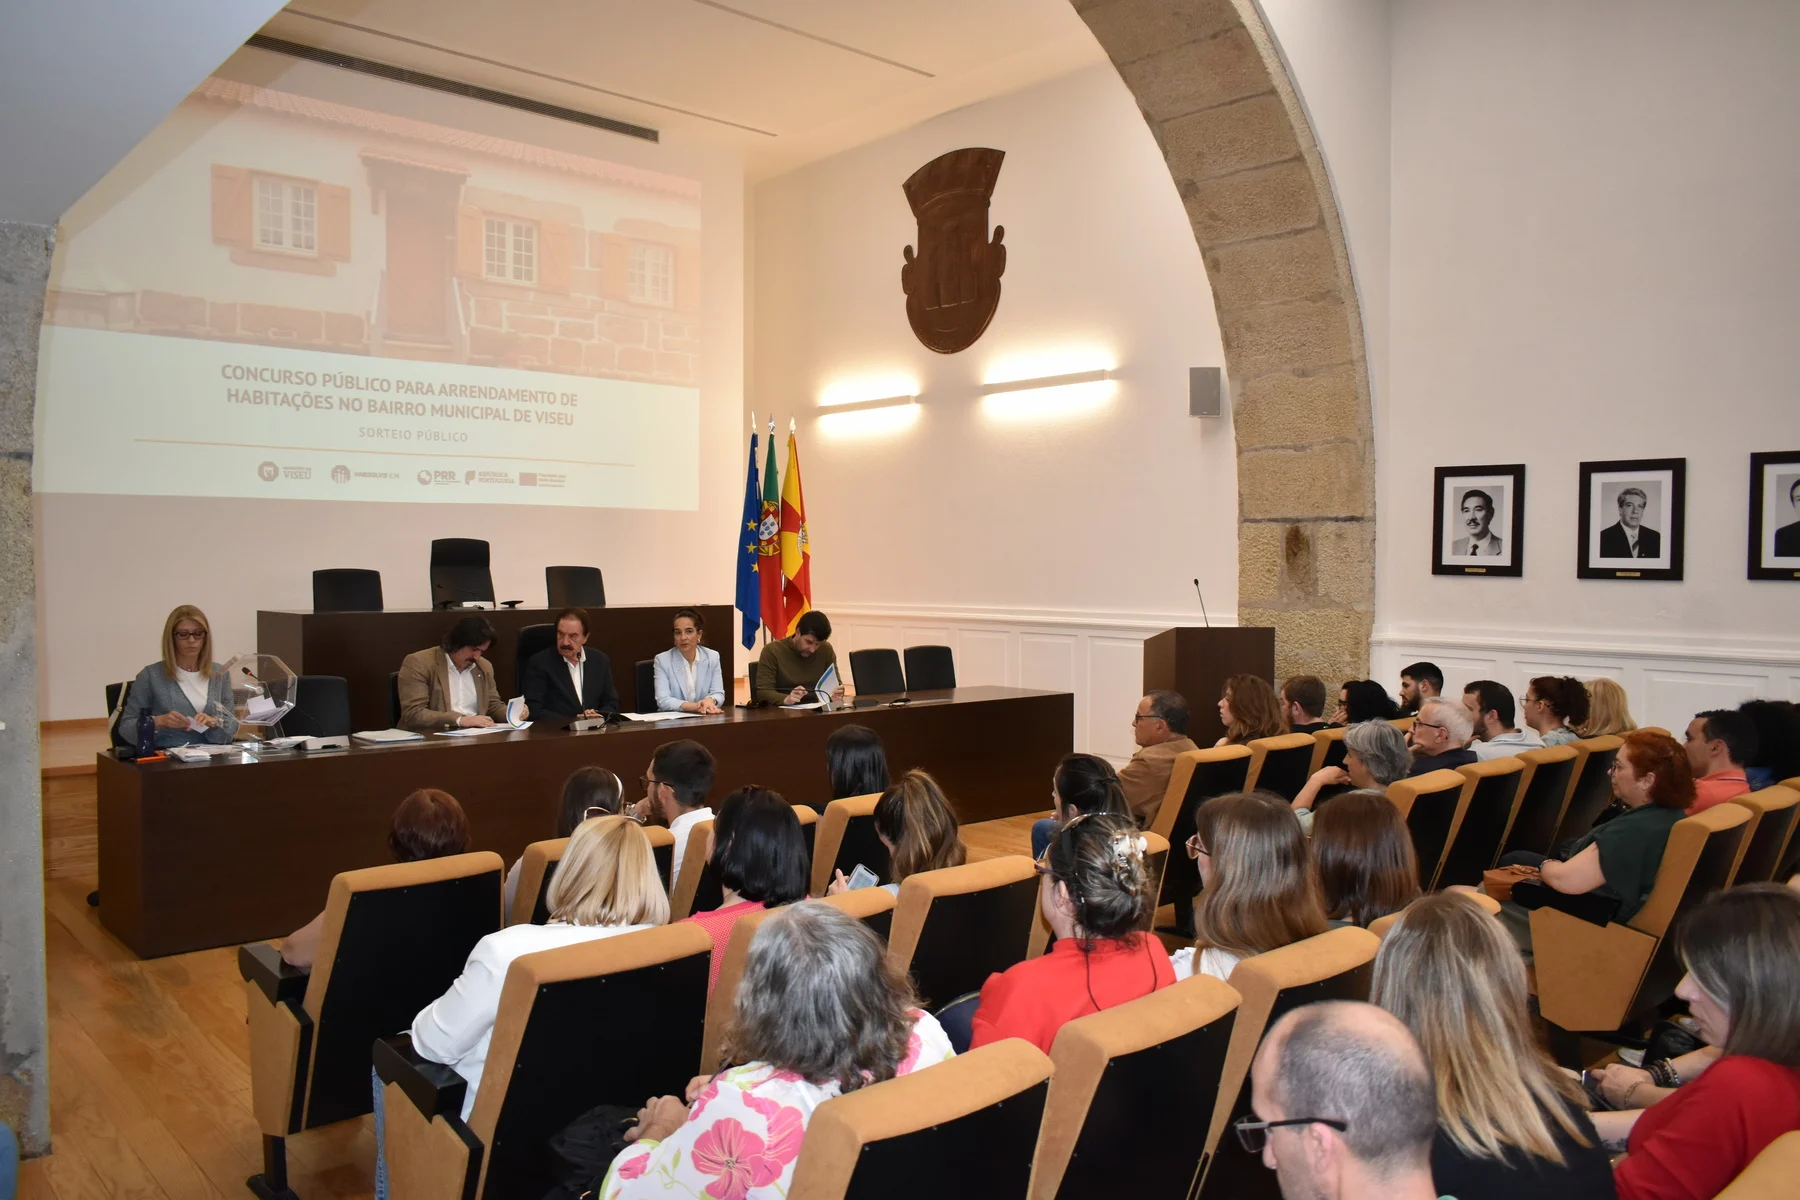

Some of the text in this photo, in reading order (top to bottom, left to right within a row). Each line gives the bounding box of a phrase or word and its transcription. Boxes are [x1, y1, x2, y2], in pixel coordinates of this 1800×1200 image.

[221, 364, 578, 407] CONCURSO PÚBLICO PARA ARRENDAMENTO DE
[226, 388, 574, 426] HABITAÇÕES NO BAIRRO MUNICIPAL DE VISEU
[358, 427, 468, 443] SORTEIO PÚBLICO
[283, 470, 312, 480] VISEU
[433, 470, 456, 480] PRR
